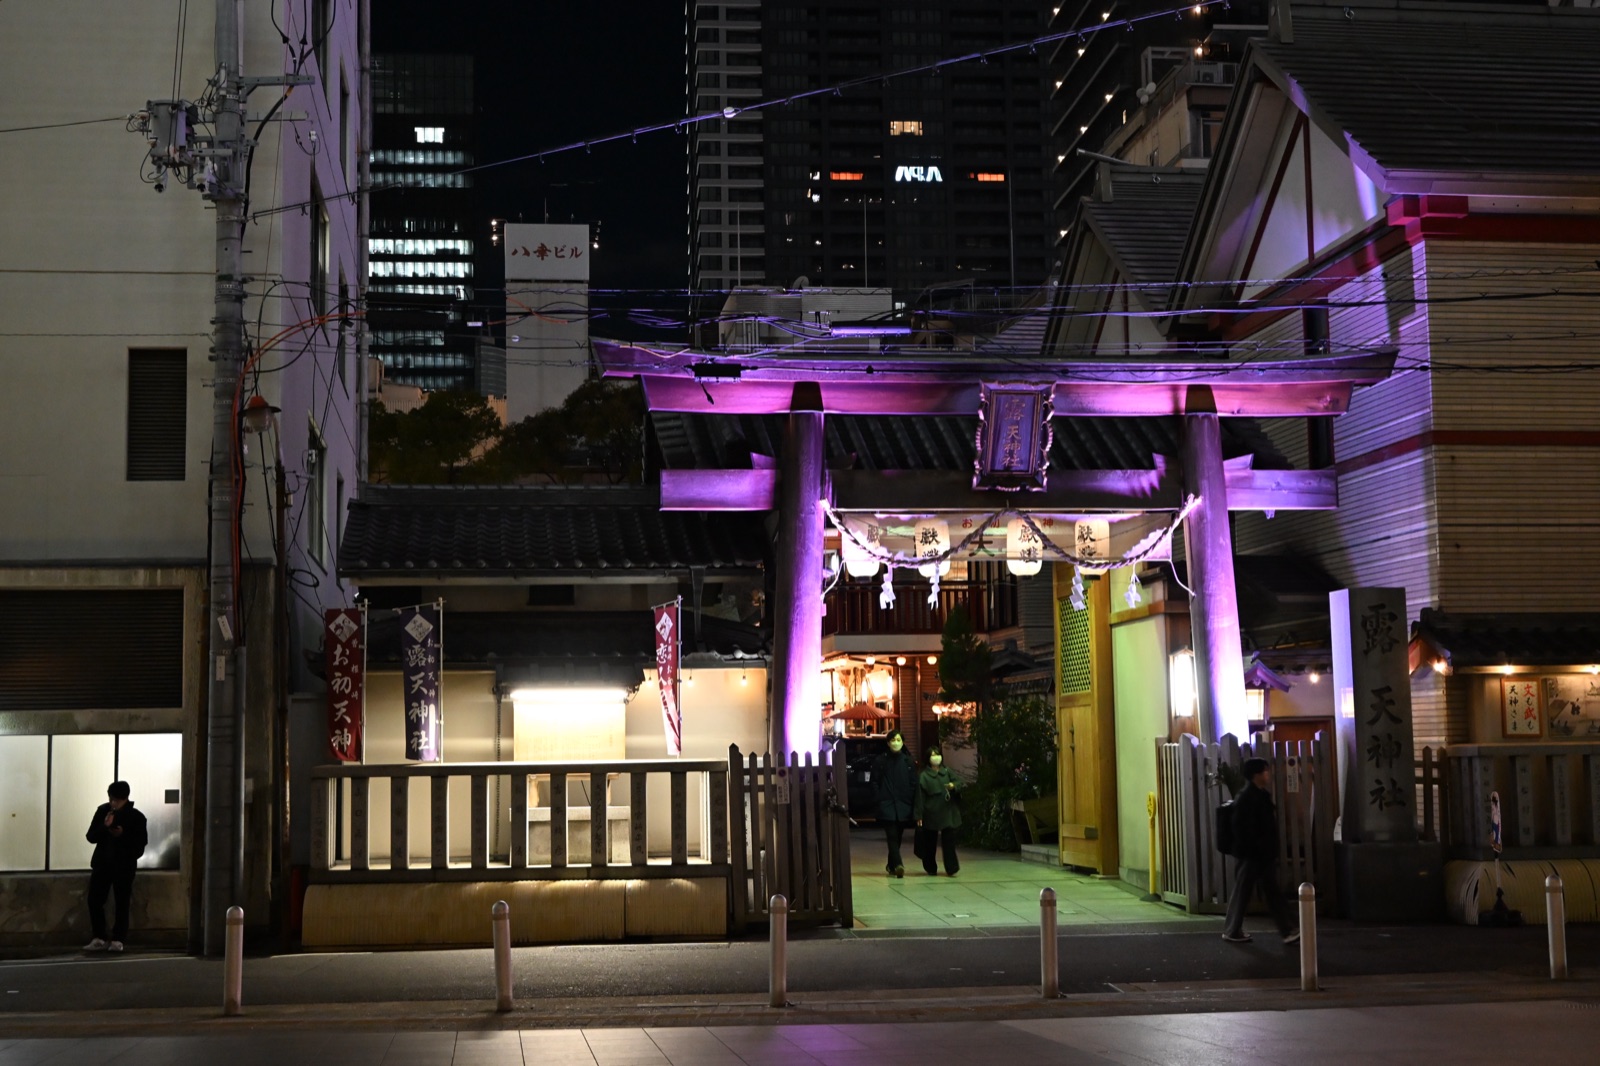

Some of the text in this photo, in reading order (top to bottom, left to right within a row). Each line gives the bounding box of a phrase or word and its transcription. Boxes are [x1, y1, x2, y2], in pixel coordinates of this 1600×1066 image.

[1001, 398, 1026, 467] 露天神社
[331, 643, 352, 755] お初天神
[407, 645, 430, 752] 露天神社
[427, 638, 436, 699] お初天神
[1361, 603, 1407, 812] 露天神社
[1509, 684, 1519, 731] 天神さま
[1523, 683, 1537, 730] 文も武も
